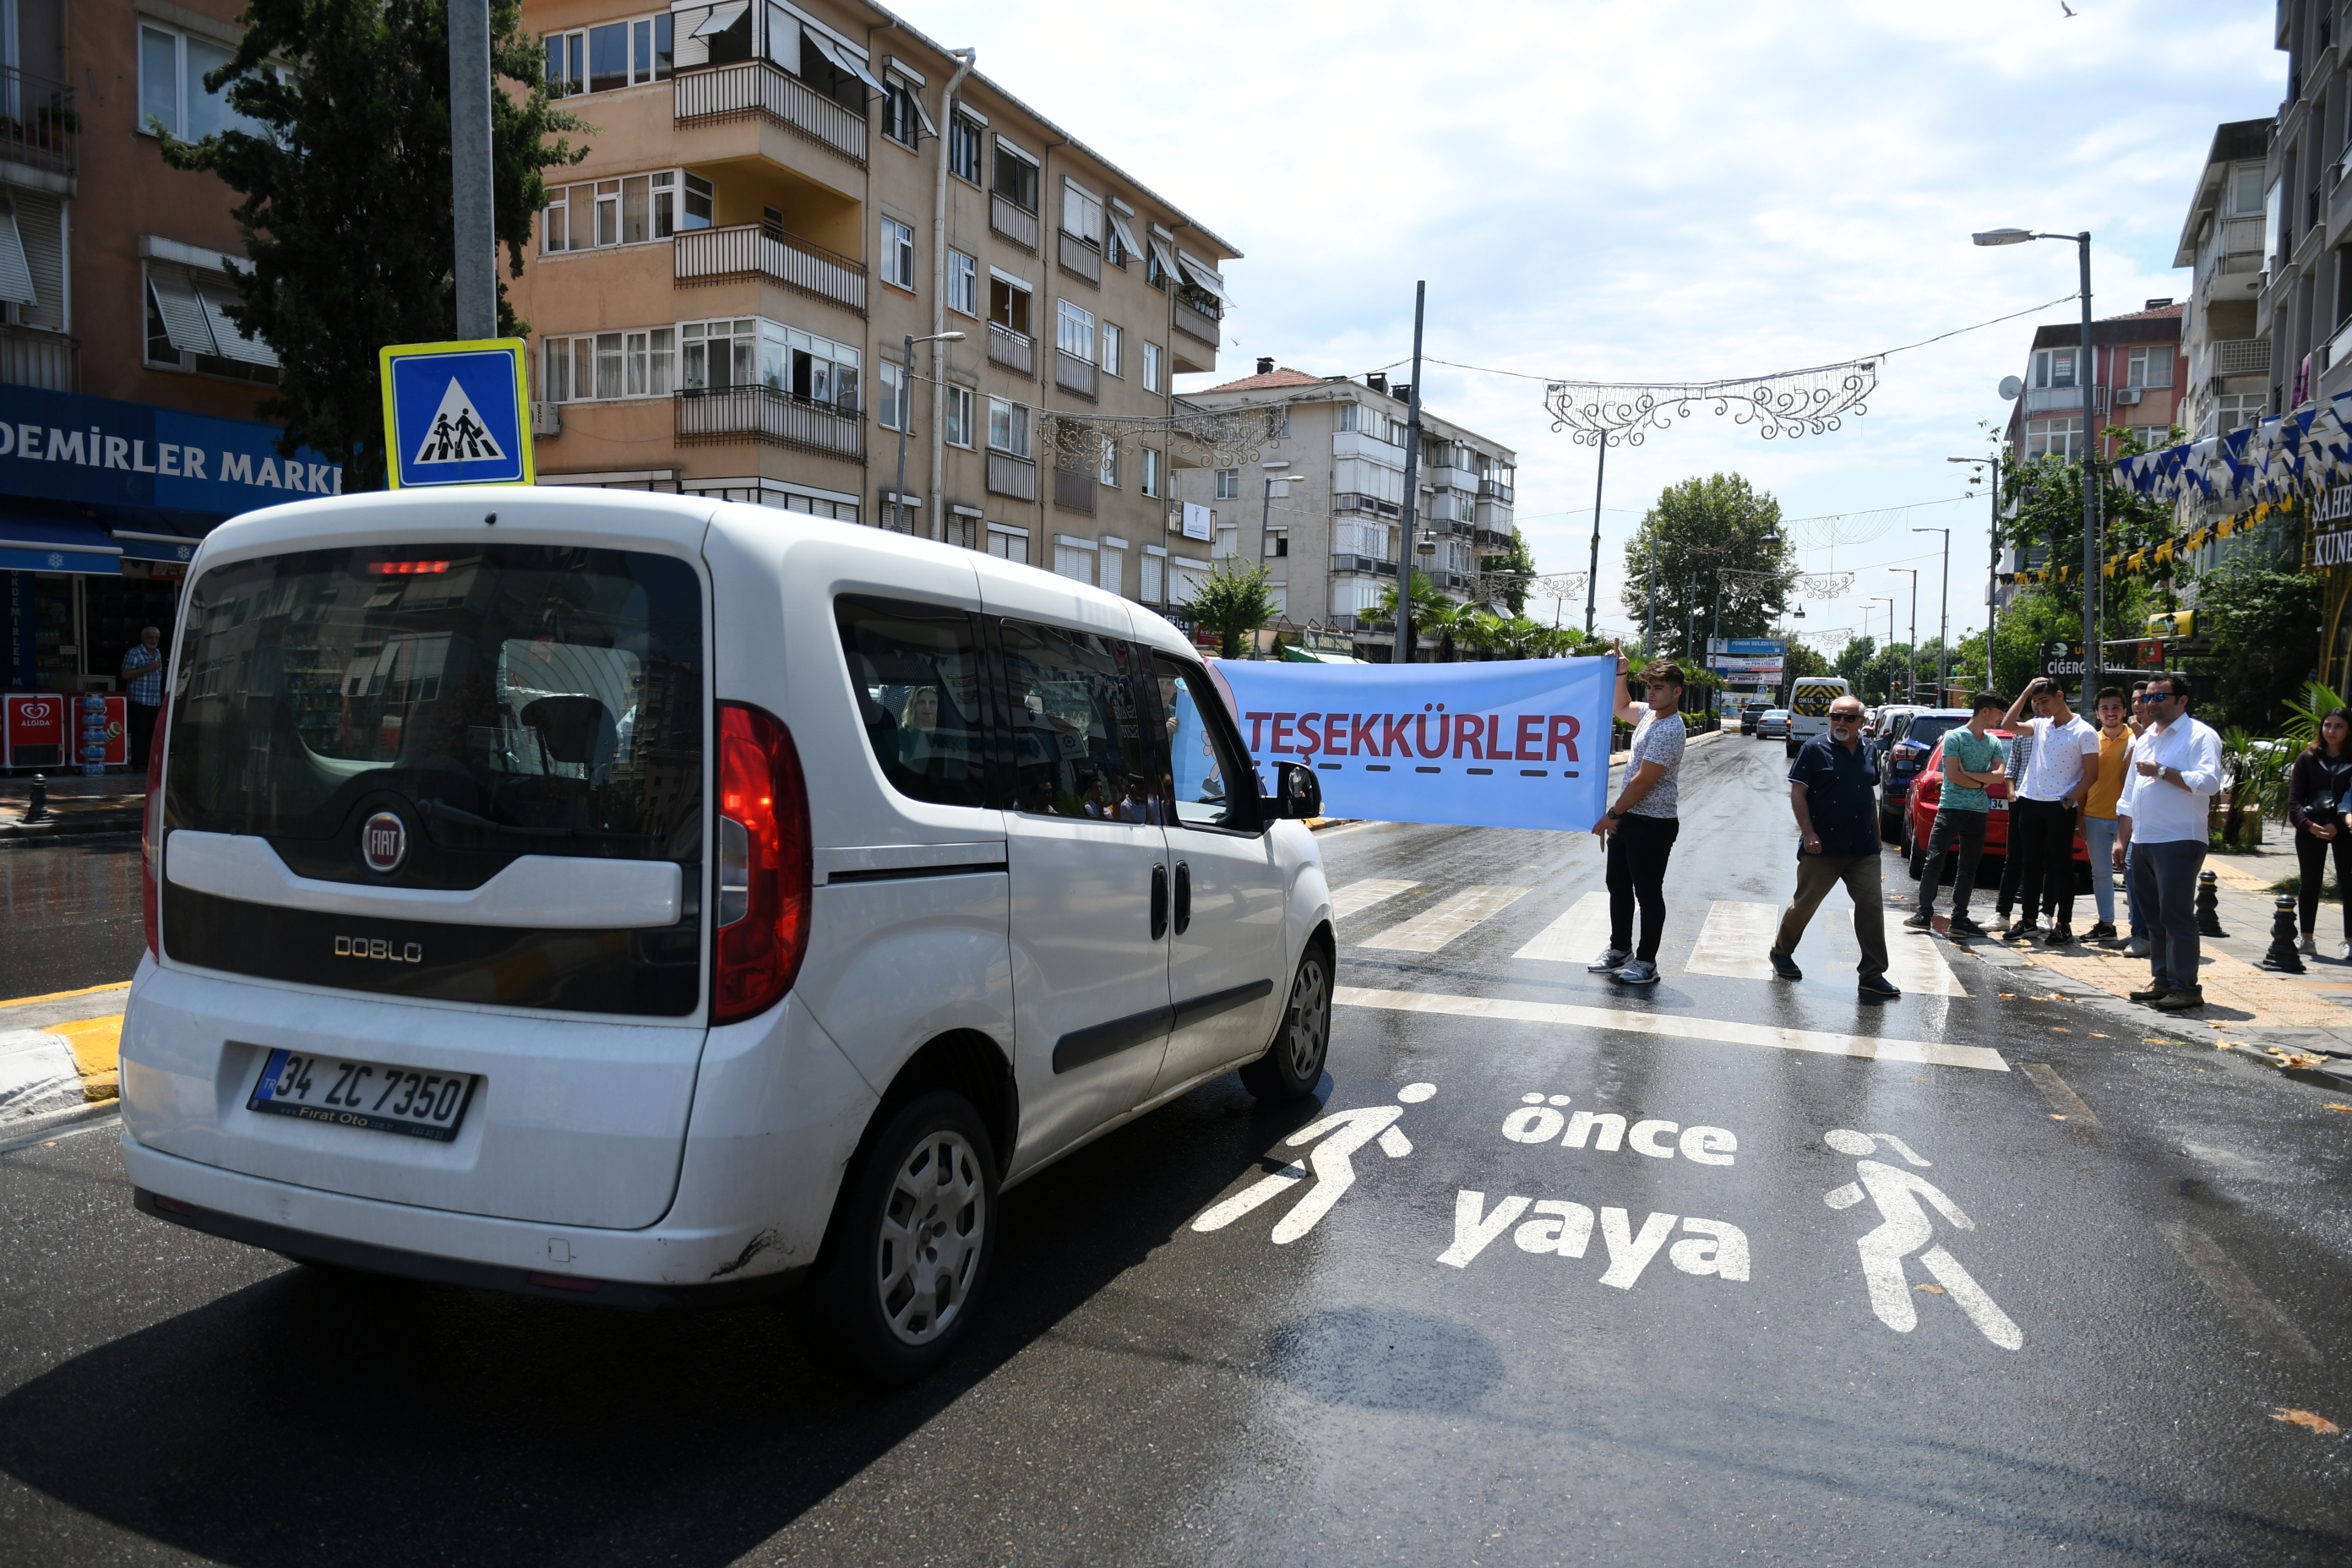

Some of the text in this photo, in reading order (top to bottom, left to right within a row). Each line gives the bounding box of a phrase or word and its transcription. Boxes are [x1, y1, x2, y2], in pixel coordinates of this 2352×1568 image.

[1245, 703, 1581, 765] TEŞEKKÜRLER
[1992, 800, 2003, 809] 34
[372, 830, 397, 856] FIAT
[335, 935, 422, 963] DOBLO
[264, 1078, 276, 1091] TR
[275, 1056, 461, 1121] 34 ZC 7350
[1502, 1092, 1738, 1166] önce
[1436, 1190, 1750, 1291] yaya
